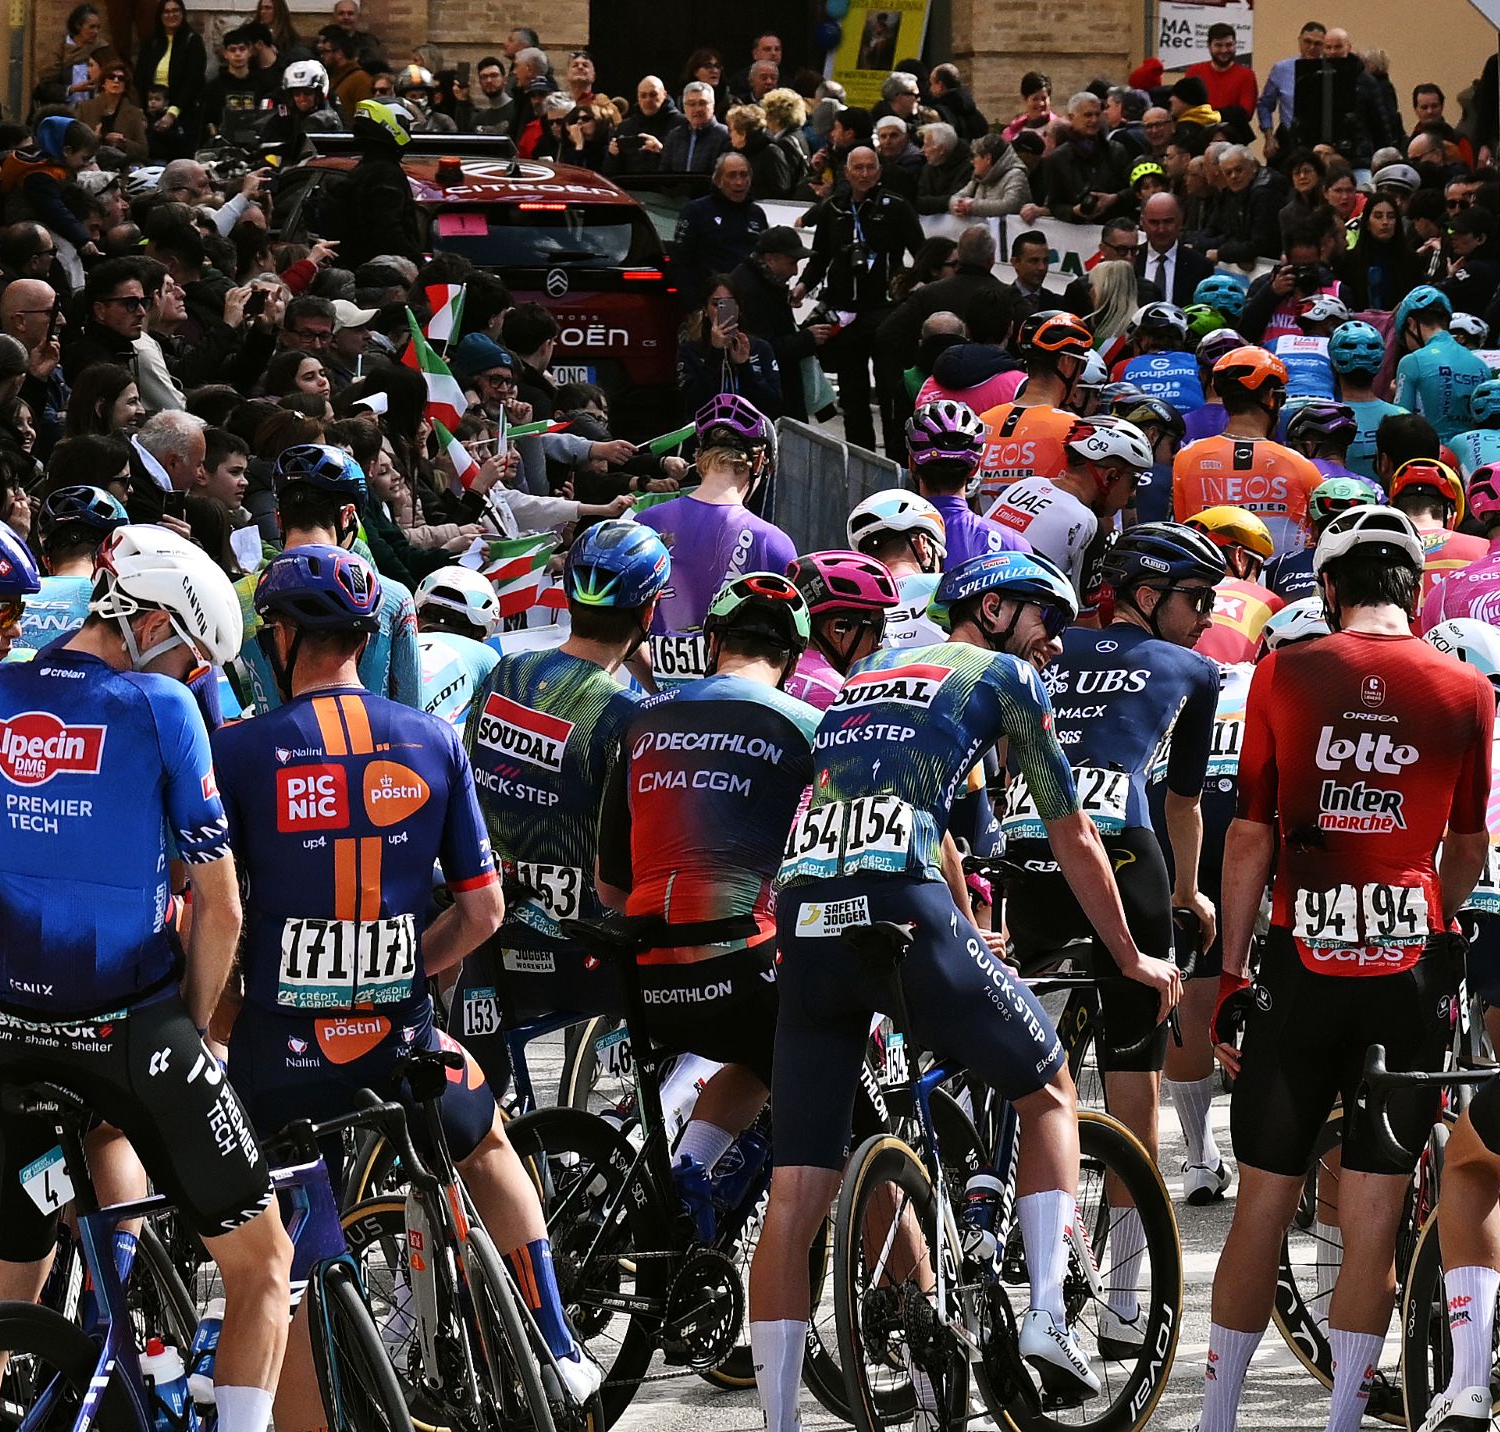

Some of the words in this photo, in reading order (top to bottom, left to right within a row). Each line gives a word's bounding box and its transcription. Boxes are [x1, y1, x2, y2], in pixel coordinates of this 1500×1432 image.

[1162, 17, 1191, 35] MA
[1160, 33, 1194, 49] Rec
[1125, 368, 1195, 380] Groupama
[1200, 476, 1288, 501] INEOS
[1008, 488, 1054, 516] UAE
[996, 507, 1028, 527] Emirates
[1141, 558, 1168, 571] ABUS
[958, 567, 1045, 598] SPECIALIZED
[182, 575, 209, 635] CANYON
[51, 667, 86, 681] crelan
[1076, 668, 1151, 695] UBS
[1343, 710, 1400, 724] ORBEA
[478, 716, 562, 767] SOUDAL
[1060, 730, 1081, 744] SGS
[292, 746, 323, 758] Nalini
[655, 732, 784, 765] DECATHLON
[15, 758, 47, 774] DMG
[287, 775, 334, 797] PIC
[371, 781, 423, 804] postnl
[638, 772, 688, 794] CMA
[690, 771, 752, 798] CGM
[6, 793, 93, 819] PREMIER
[8, 813, 60, 835] TECH
[152, 883, 165, 936] Alpecin
[824, 899, 866, 917] SAFETY
[824, 911, 869, 927] JOGGER
[299, 991, 338, 1003] CRÉDIT
[323, 1018, 383, 1038] postnl
[24, 1032, 60, 1049] shade
[72, 1039, 114, 1054] shelter
[286, 1056, 321, 1071] Nalini
[42, 1171, 60, 1210] 4
